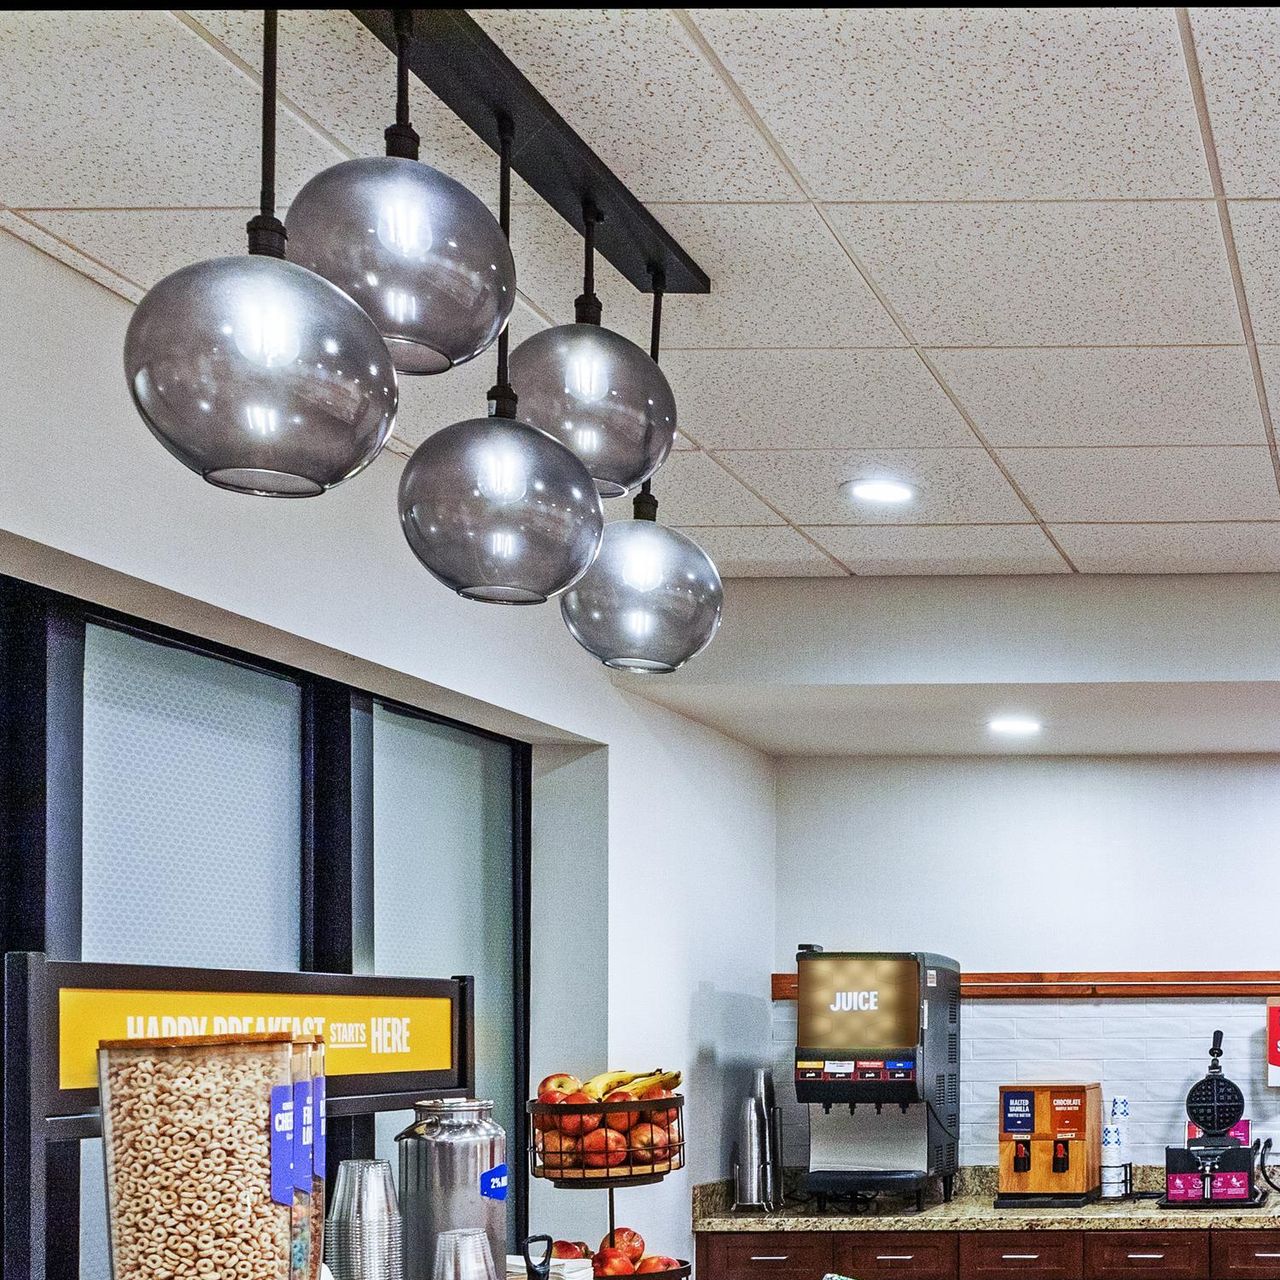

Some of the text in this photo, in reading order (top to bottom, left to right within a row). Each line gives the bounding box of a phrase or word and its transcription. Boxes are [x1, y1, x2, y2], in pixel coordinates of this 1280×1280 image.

[830, 991, 879, 1012] JUICE
[329, 1022, 366, 1043] STARTS
[370, 1017, 411, 1054] HERE
